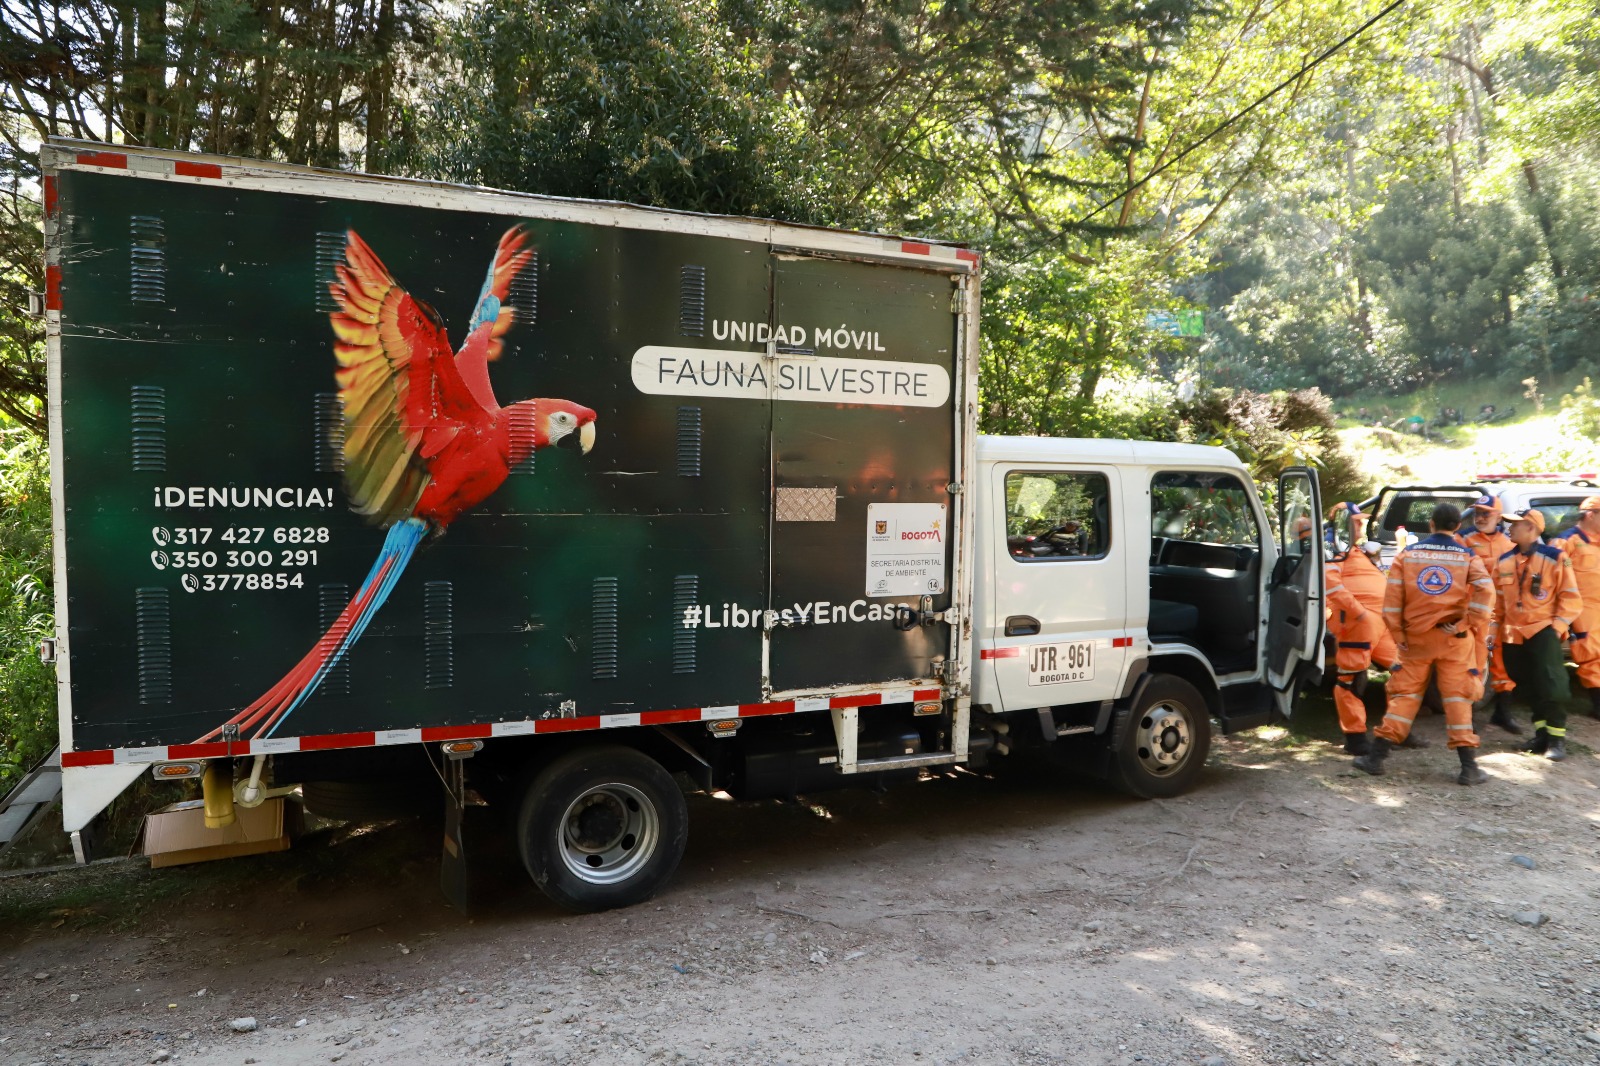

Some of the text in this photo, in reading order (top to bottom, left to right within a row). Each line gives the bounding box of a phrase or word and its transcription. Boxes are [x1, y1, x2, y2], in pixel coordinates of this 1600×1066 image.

[712, 319, 886, 353] UNIDAD MÓVIL
[658, 357, 929, 397] FAUNA SILVESTRE
[153, 486, 334, 508] ¡DENUNCIA!
[174, 526, 330, 545] 317 427 6828
[171, 549, 318, 568] 350 300 291
[910, 559, 942, 567] DISTRITAL
[1411, 551, 1465, 561] COLOMBIA
[202, 572, 305, 591] 3778854
[895, 569, 927, 577] AMBIENTE
[929, 581, 938, 589] 14
[1030, 646, 1058, 673] JTR
[1068, 643, 1092, 669] 961
[1040, 673, 1070, 683] BOGOTA
